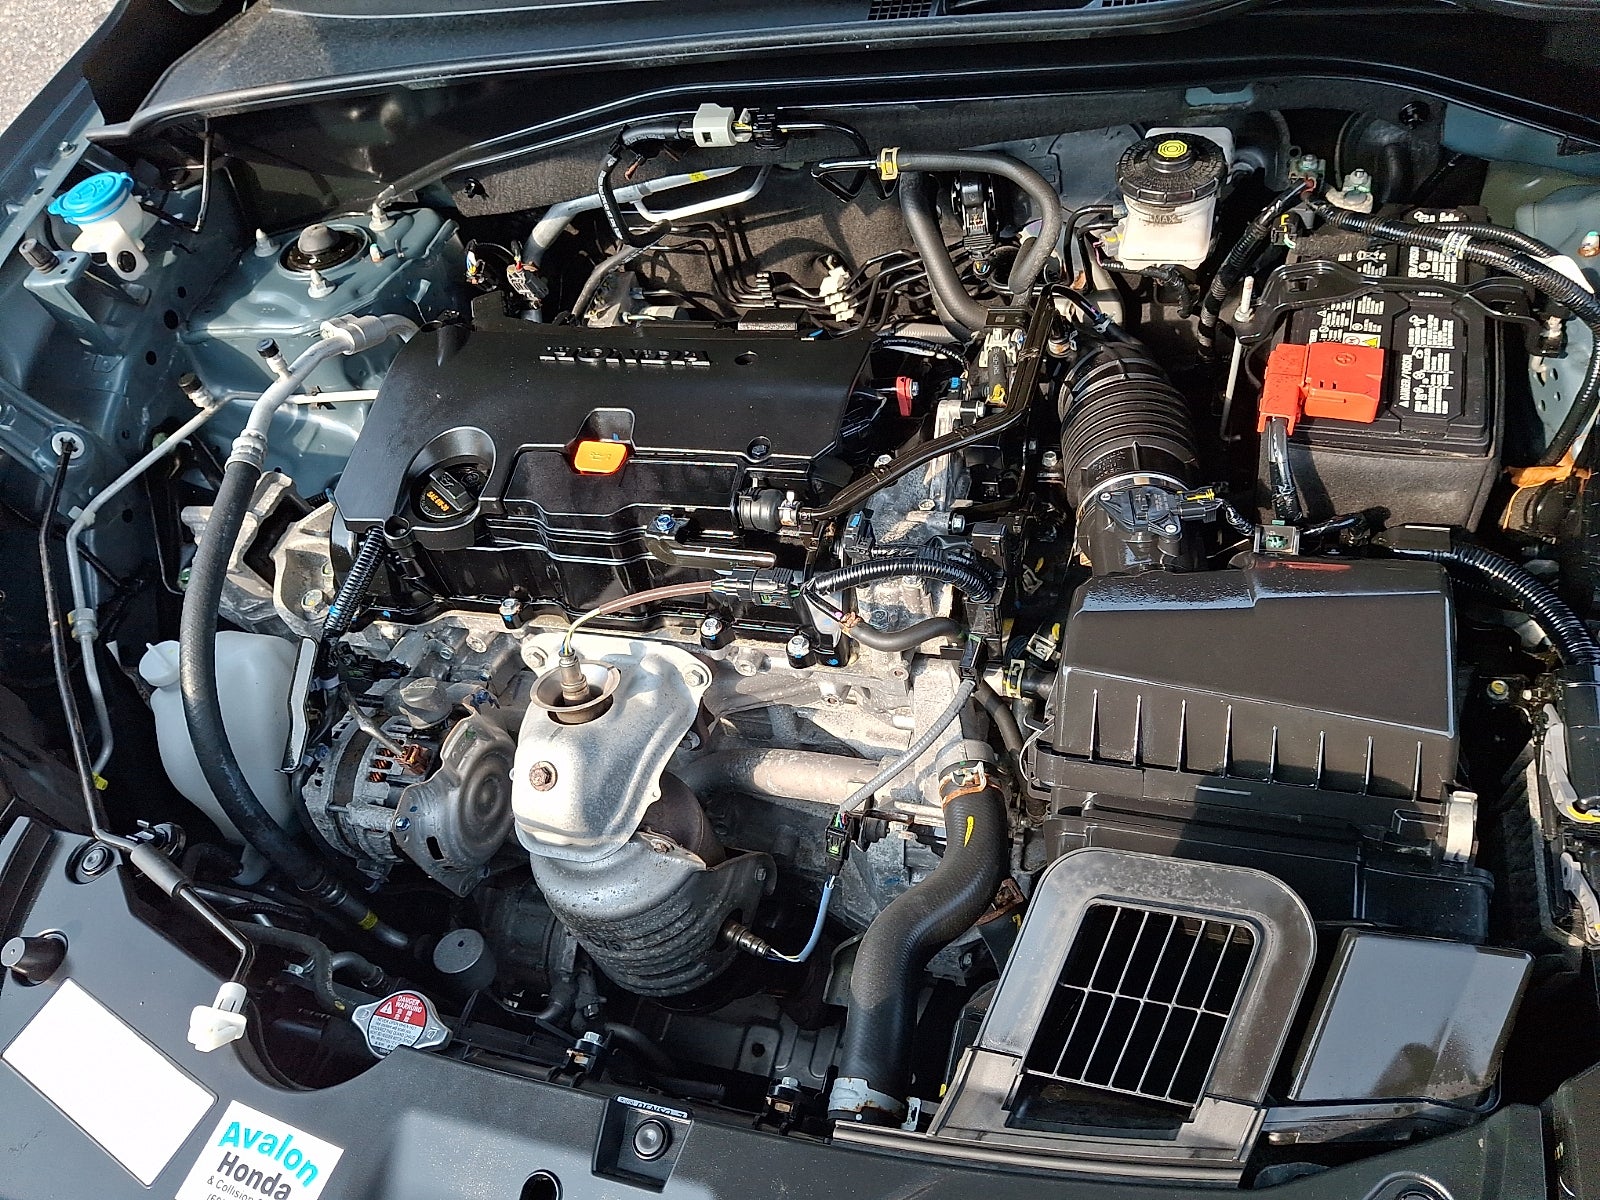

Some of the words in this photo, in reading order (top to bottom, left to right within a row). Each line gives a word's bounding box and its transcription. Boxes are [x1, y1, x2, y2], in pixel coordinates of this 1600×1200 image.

[1153, 214, 1176, 224] MAX
[395, 1001, 423, 1013] WARNING
[397, 995, 421, 1007] DANGER
[217, 1121, 320, 1188] Avalon
[206, 1175, 215, 1186] &
[216, 1151, 292, 1200] Honda
